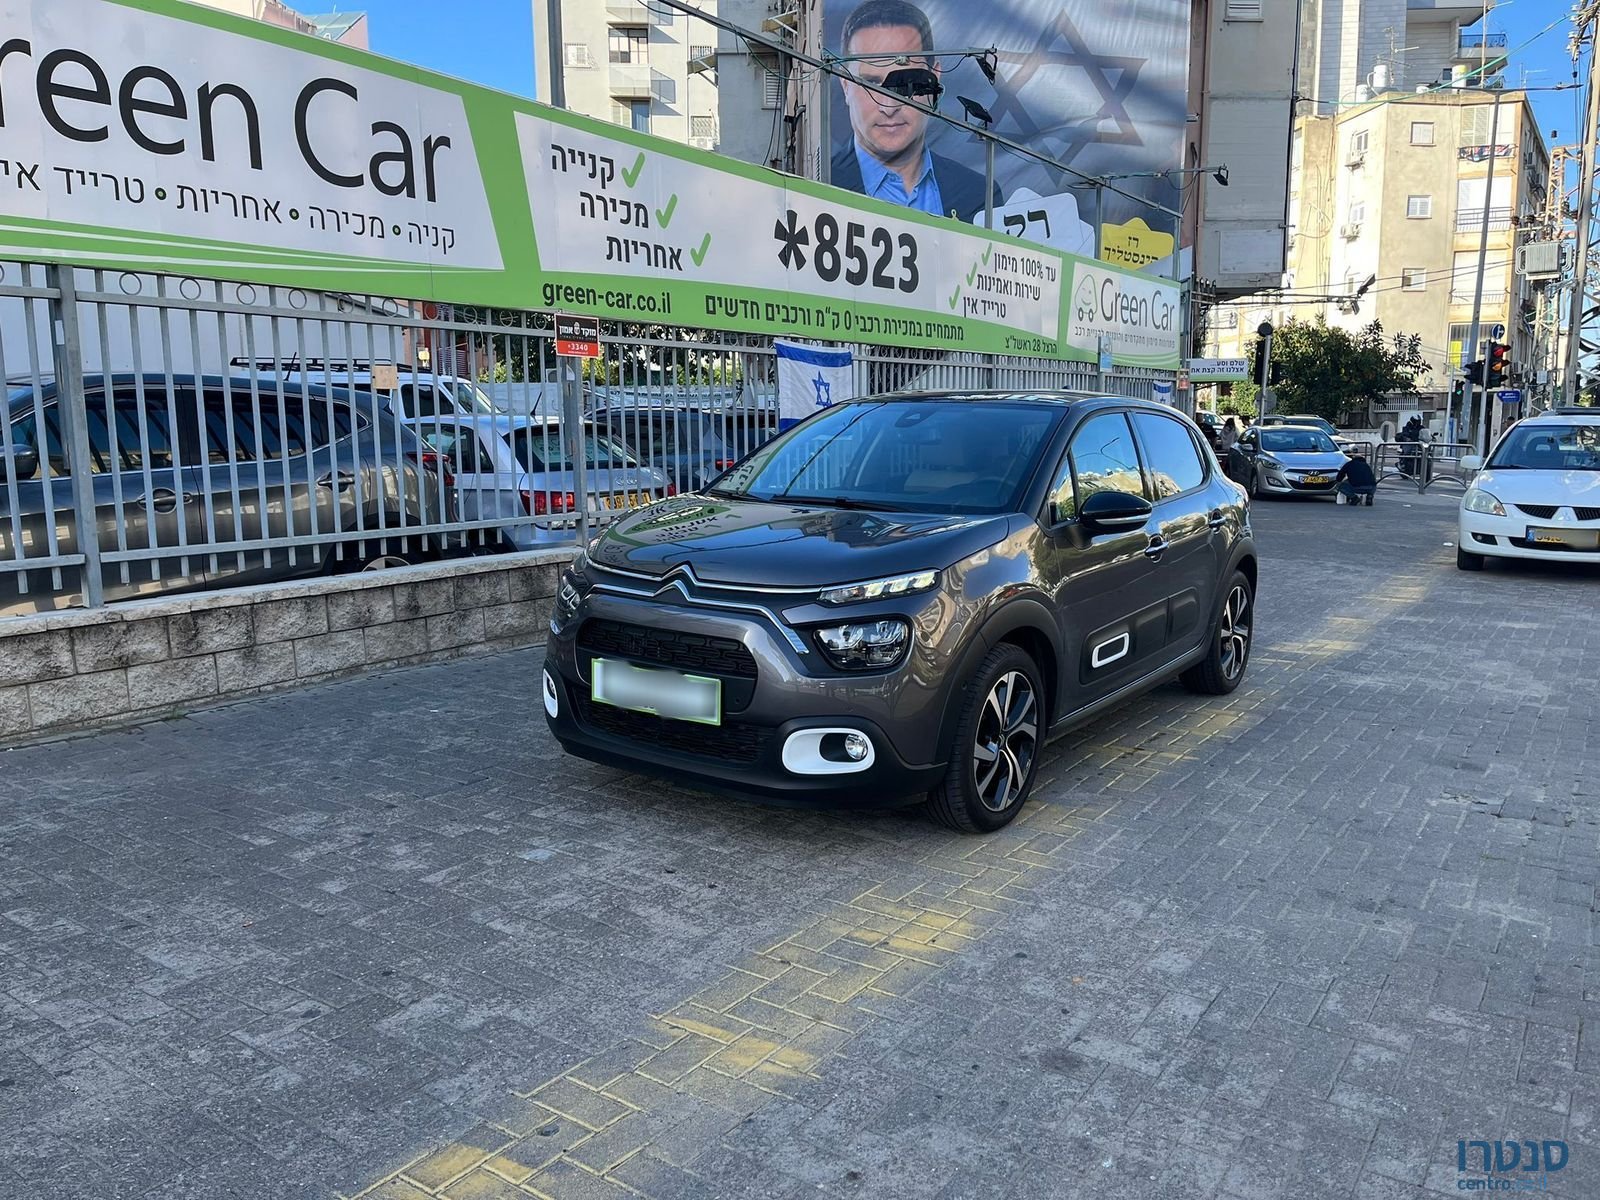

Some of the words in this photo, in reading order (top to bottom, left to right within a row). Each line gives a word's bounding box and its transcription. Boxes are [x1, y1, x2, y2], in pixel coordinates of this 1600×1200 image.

[0, 38, 263, 171] reen
[294, 77, 452, 203] Car
[0, 159, 41, 191] אי
[551, 144, 615, 189] קנייה
[53, 166, 145, 204] טרייד
[177, 185, 282, 224] אחריות
[580, 191, 649, 228] מכירה
[309, 206, 385, 239] מכירה
[407, 221, 455, 255] קניה
[606, 236, 683, 271] אחריות
[994, 252, 1018, 273] מימון
[1021, 257, 1044, 278] 100%
[1046, 267, 1057, 282] עד
[977, 274, 1013, 295] ואמינות
[1015, 283, 1041, 301] שירות
[542, 282, 671, 314] green-car.co.il
[705, 295, 760, 321] חדשים
[963, 296, 978, 318] אין
[981, 299, 1007, 319] טרייד
[1101, 278, 1148, 327] Green
[1151, 290, 1175, 331] Car
[765, 302, 811, 326] ורכבים
[844, 311, 852, 330] 0
[855, 315, 881, 333] רכבי
[581, 327, 597, 337] מוקד
[884, 318, 923, 337] במכירת
[926, 323, 964, 341] מתמחים
[1032, 338, 1041, 352] 28
[1042, 339, 1058, 354] הרצל
